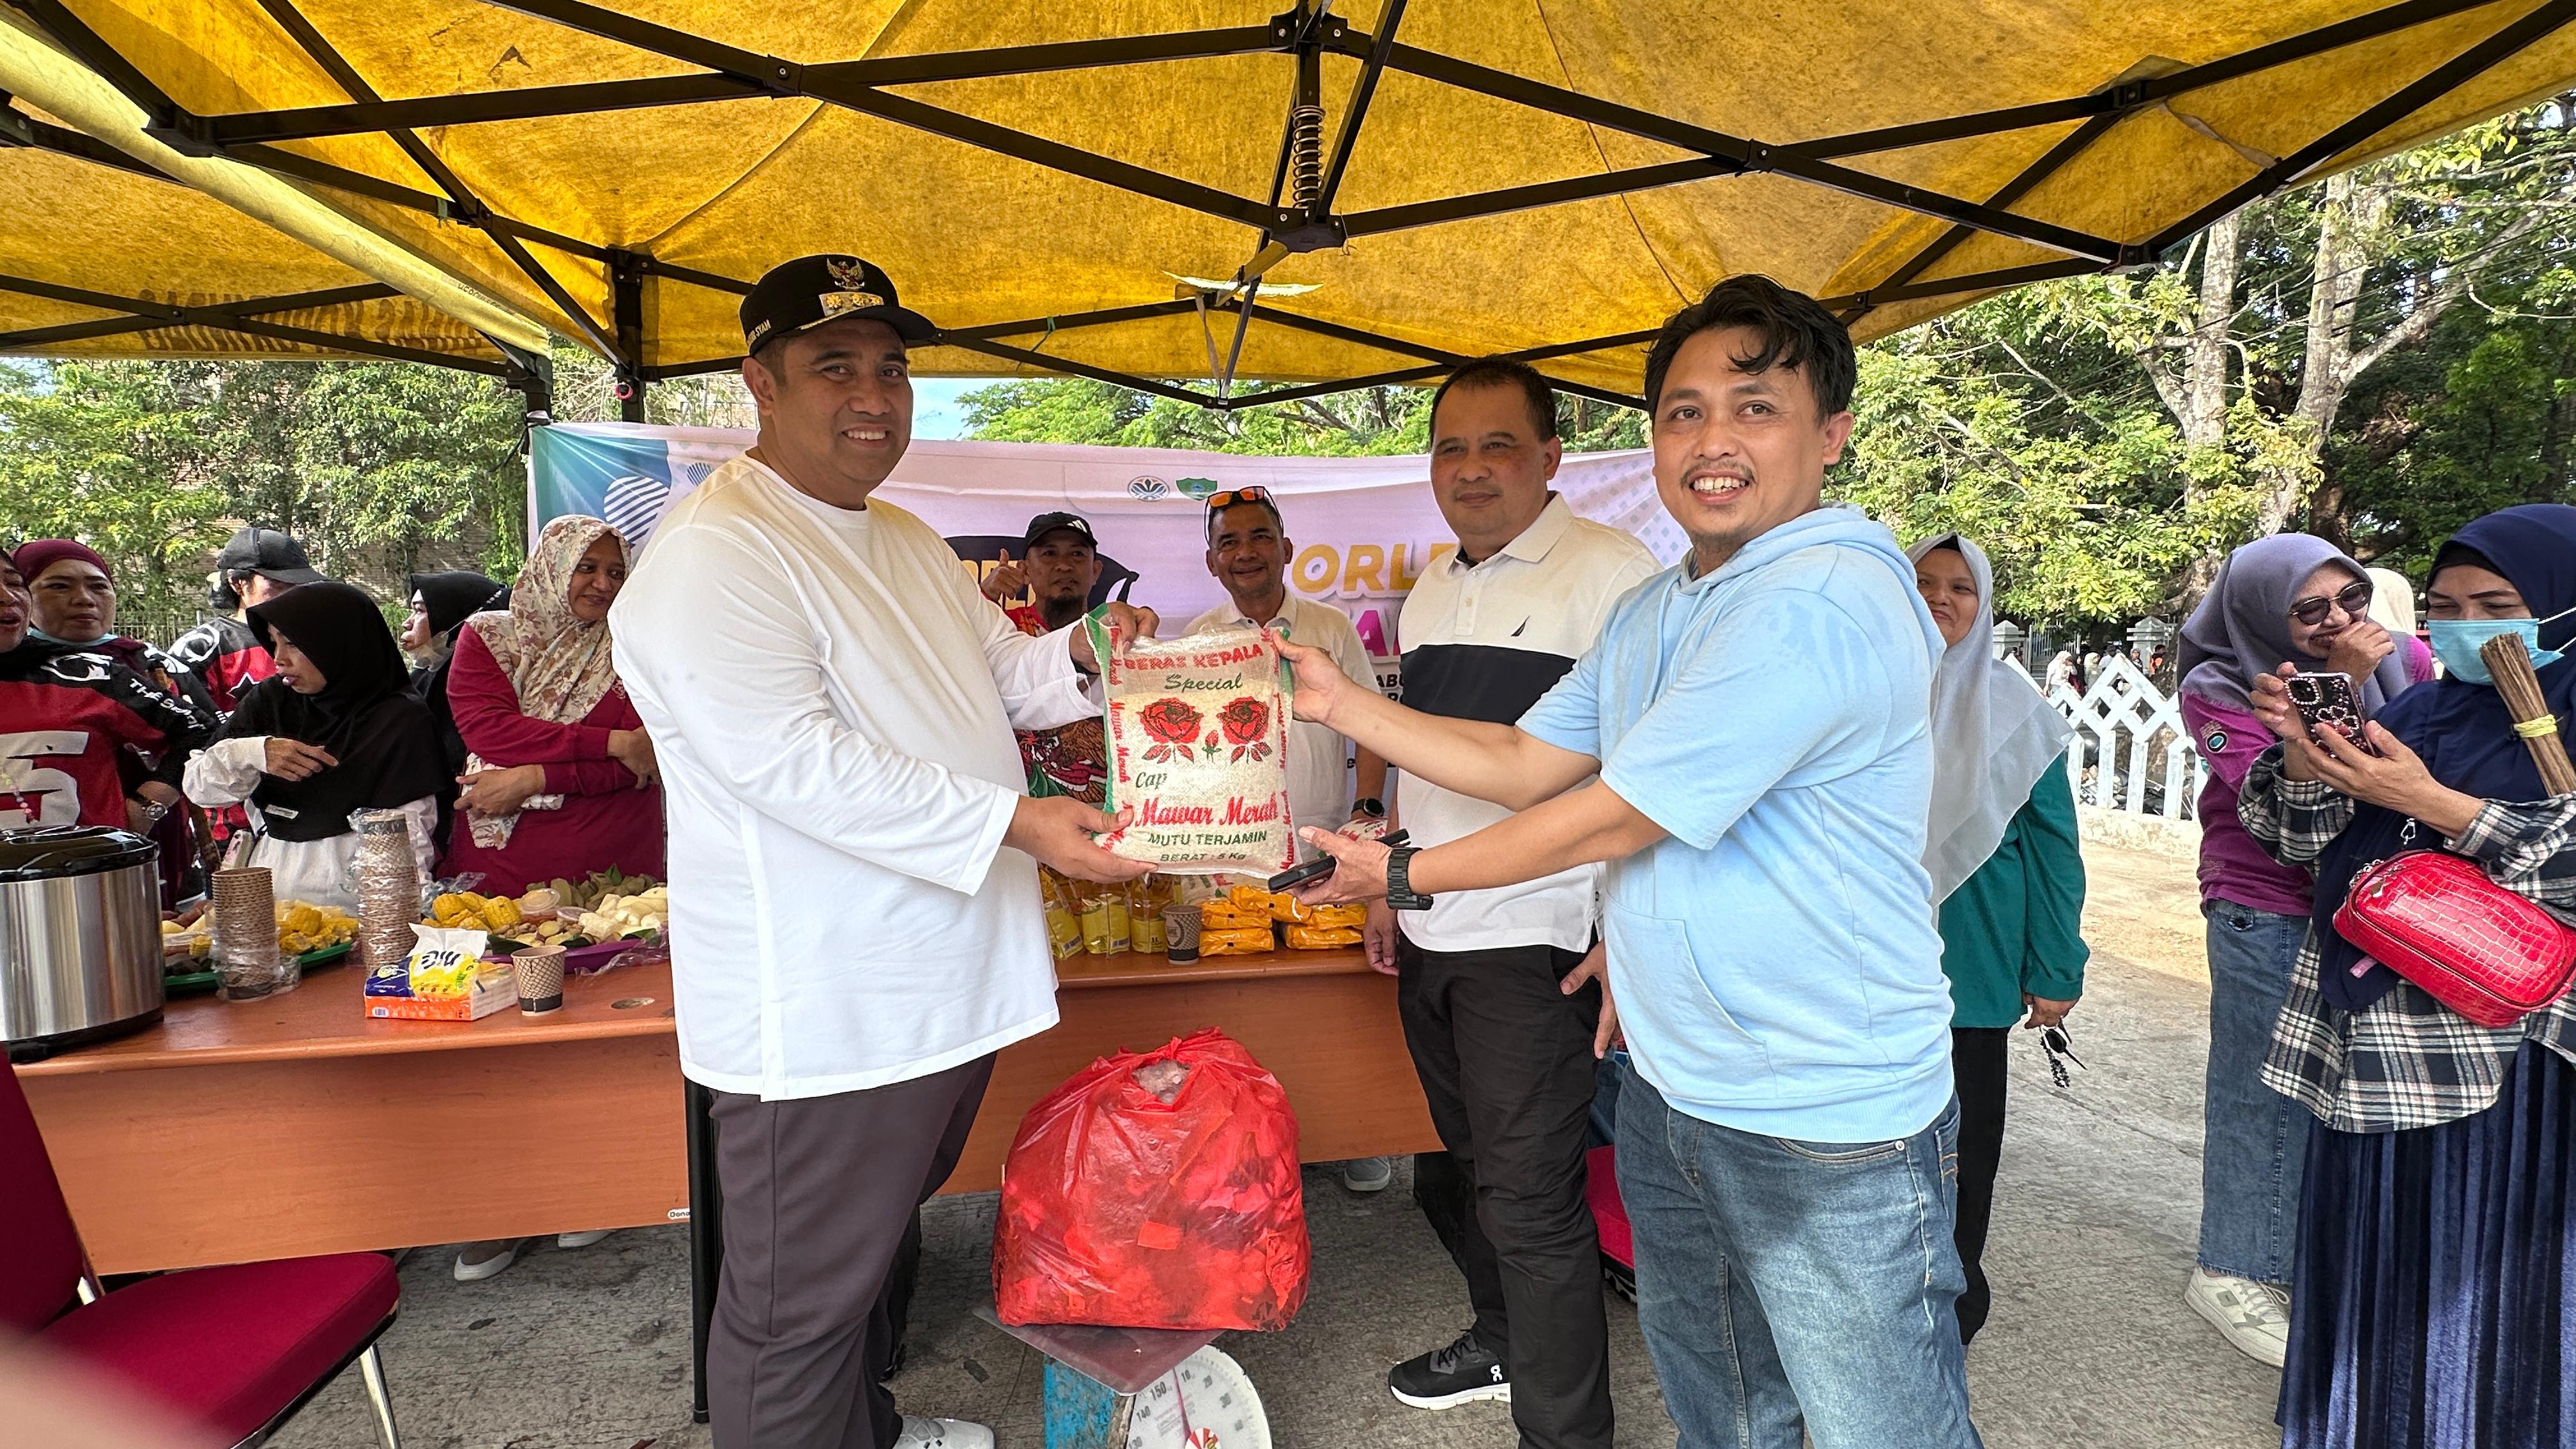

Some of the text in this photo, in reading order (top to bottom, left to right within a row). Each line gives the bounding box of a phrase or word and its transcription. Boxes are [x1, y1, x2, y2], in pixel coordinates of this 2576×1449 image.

[1192, 643, 1264, 669] KEPALA
[1164, 672, 1243, 693] Special
[1108, 698, 1126, 740] Mawar
[1116, 744, 1131, 784] Merah
[1135, 772, 1168, 790] Cap
[1135, 792, 1278, 827] Mawar Merah
[1148, 830, 1268, 847] MUTU TERJAMIN
[1160, 853, 1208, 862] BERAT
[1181, 1369, 1192, 1383] 10
[1150, 1381, 1168, 1401] 150
[1136, 1406, 1151, 1422] 140
